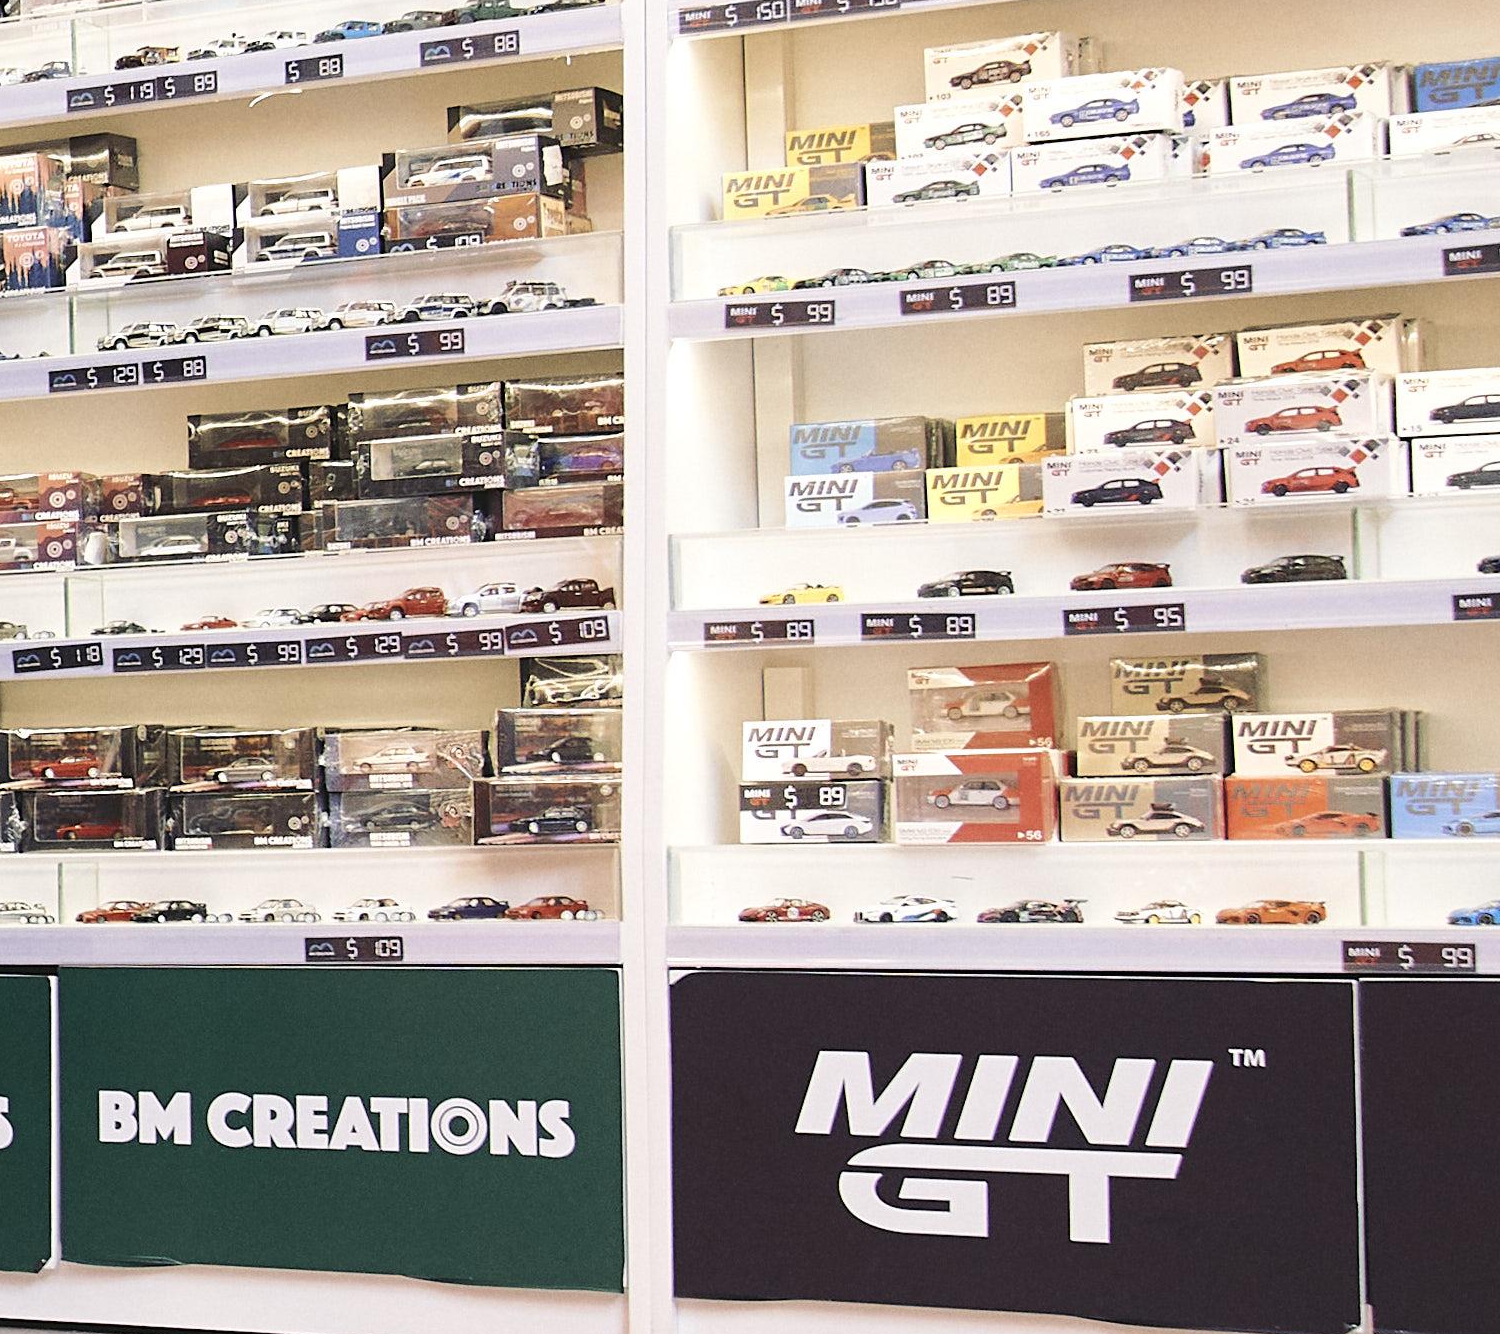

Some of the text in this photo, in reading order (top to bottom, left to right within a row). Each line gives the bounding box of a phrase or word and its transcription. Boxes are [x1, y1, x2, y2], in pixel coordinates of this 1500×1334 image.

[462, 33, 517, 59] $ 88
[288, 58, 340, 82] $ 88
[104, 82, 154, 105] $ 119
[164, 74, 215, 98] $ 89
[789, 129, 857, 152] MINI
[796, 144, 853, 165] GT
[726, 173, 795, 194] MINI
[733, 188, 792, 208] GT
[6, 231, 45, 242] TOYOTA
[1135, 270, 1249, 296] MINI $ 99
[408, 332, 463, 355] $ 99
[87, 365, 138, 388] $ 129
[153, 359, 205, 381] $ 88
[961, 420, 1032, 439] MINI
[968, 436, 1027, 454] GT
[789, 479, 859, 497] MINI
[931, 470, 1003, 490] MINI
[796, 494, 853, 512] GT
[940, 487, 998, 505] GT
[1068, 606, 1182, 630] MINI $ 95
[549, 619, 607, 643] $ 109
[346, 635, 400, 659] $ 129
[447, 631, 501, 654] $ 99
[50, 645, 100, 668] $ 118
[152, 646, 204, 668] $ 129
[247, 644, 300, 664] $ 99
[749, 726, 816, 742] MINI
[1080, 720, 1155, 737] MINI
[1238, 719, 1317, 737] MINI
[755, 743, 811, 758] GT
[1087, 737, 1149, 755] GT
[1246, 737, 1310, 755] GT
[744, 785, 844, 808] MINI $ 89
[1026, 830, 1042, 841] 56
[347, 938, 400, 958] $ 109
[1228, 1049, 1266, 1067] TM
[794, 1050, 1214, 1148] MINI
[100, 1089, 575, 1158] BM CREATIONS
[838, 1144, 1183, 1244] GT
